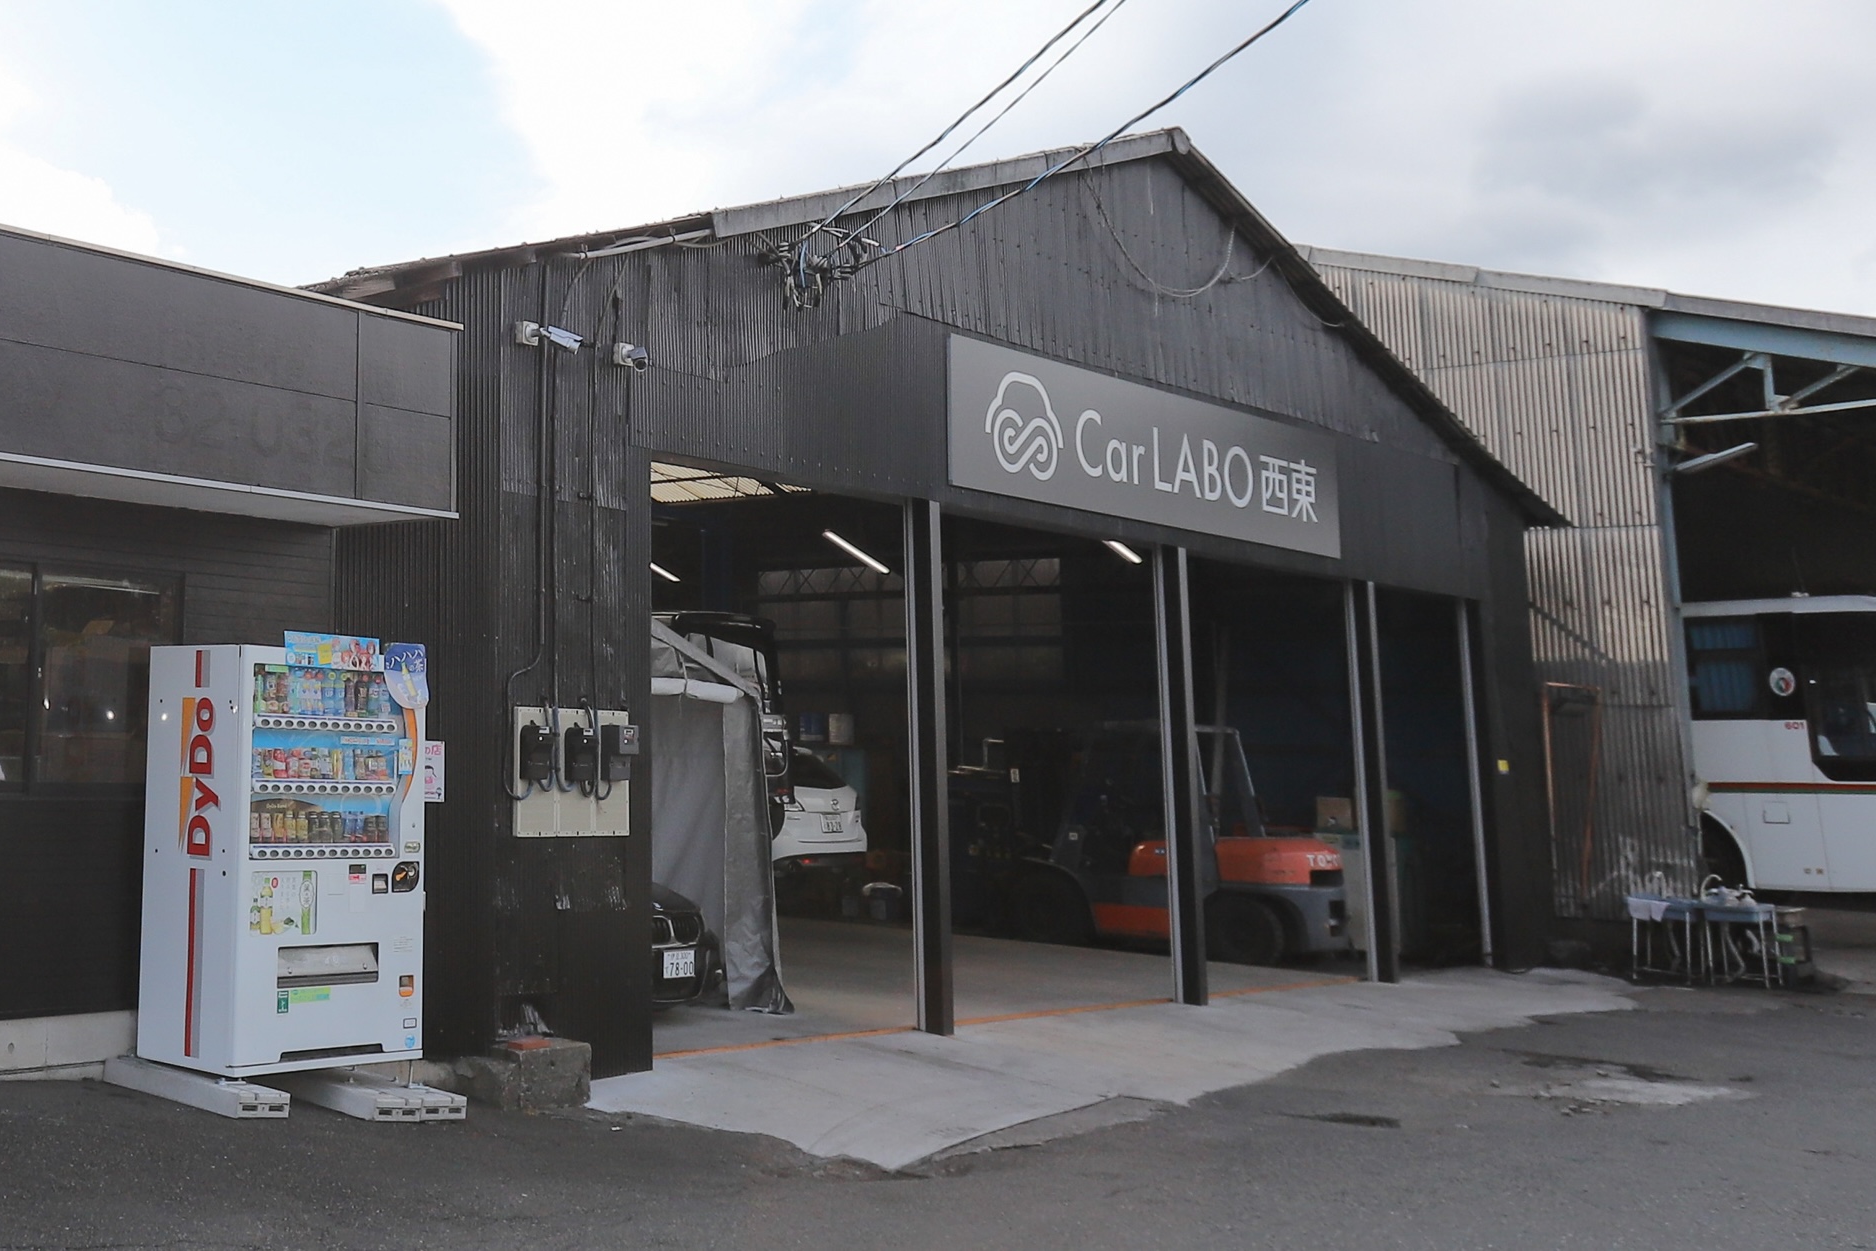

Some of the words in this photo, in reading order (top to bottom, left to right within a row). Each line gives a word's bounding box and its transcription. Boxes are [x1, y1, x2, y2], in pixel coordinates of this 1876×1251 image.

[1075, 408, 1145, 485] Car
[1152, 426, 1254, 509] LABO
[1260, 454, 1319, 523] 西東
[187, 697, 220, 857] DyDo
[670, 961, 694, 977] 78-00
